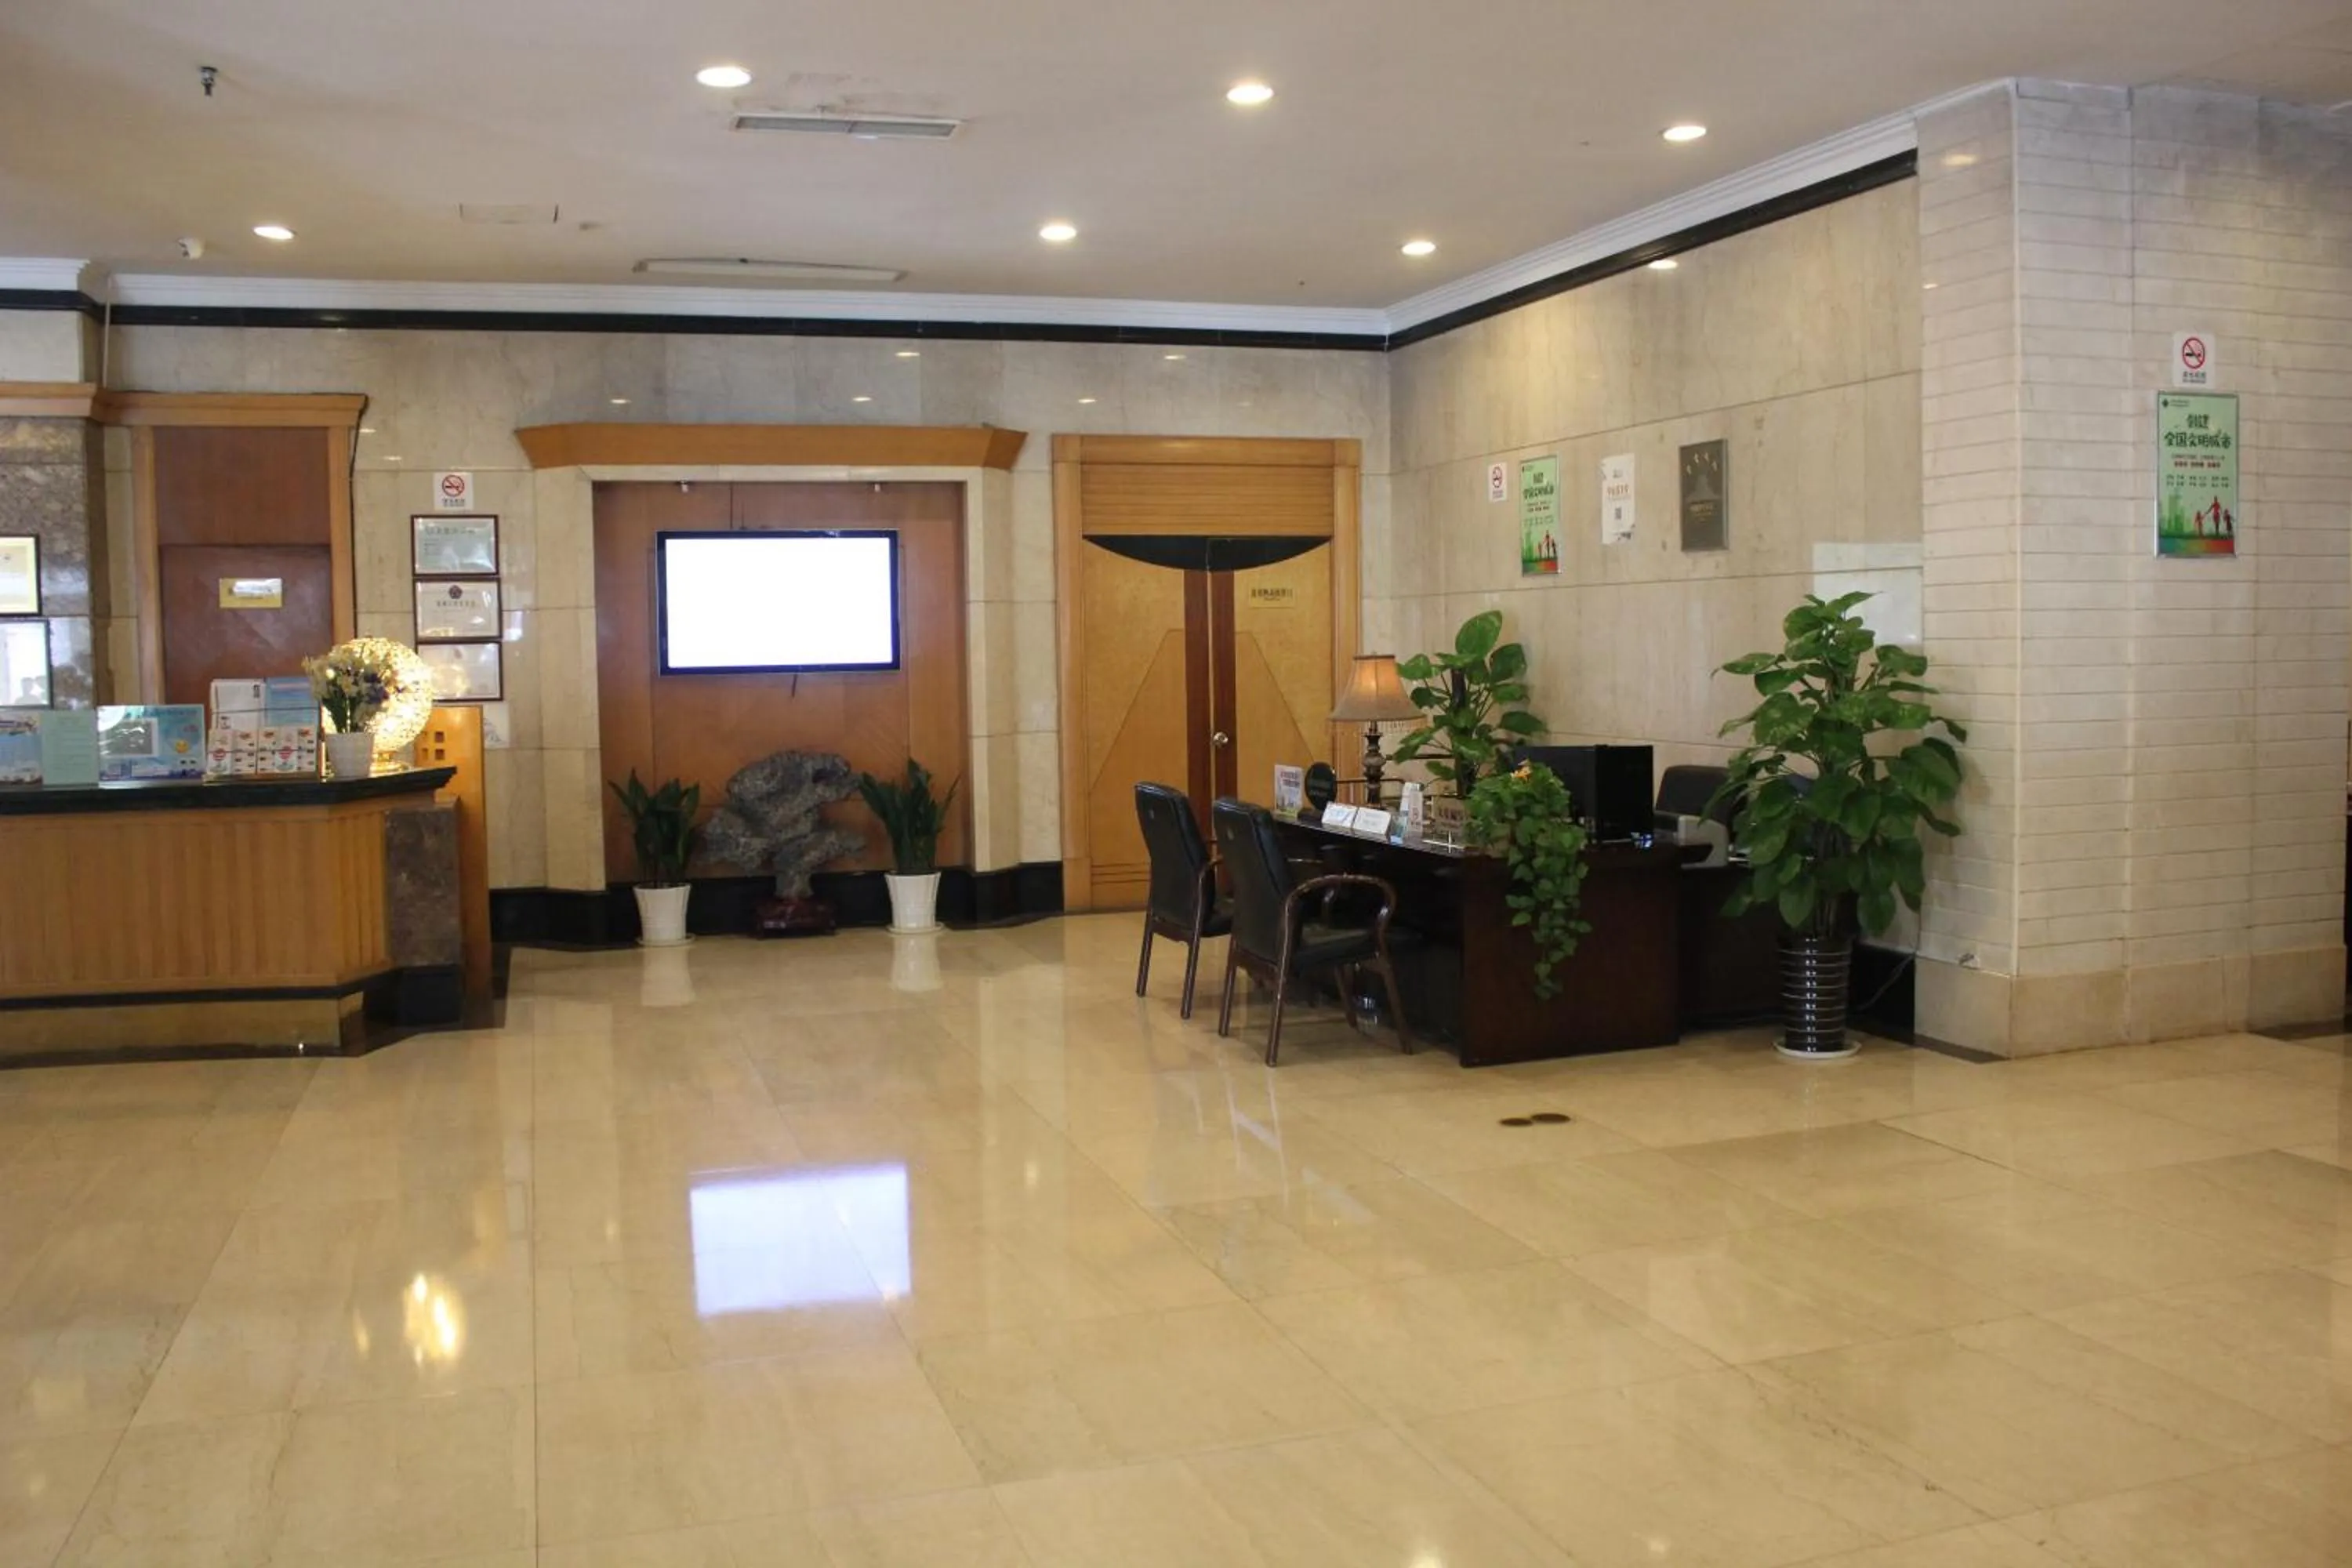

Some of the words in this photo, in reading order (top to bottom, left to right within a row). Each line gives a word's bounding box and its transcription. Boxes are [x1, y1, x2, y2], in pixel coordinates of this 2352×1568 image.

[2187, 413, 2209, 429] 创建
[2164, 430, 2231, 449] 全国文明城市
